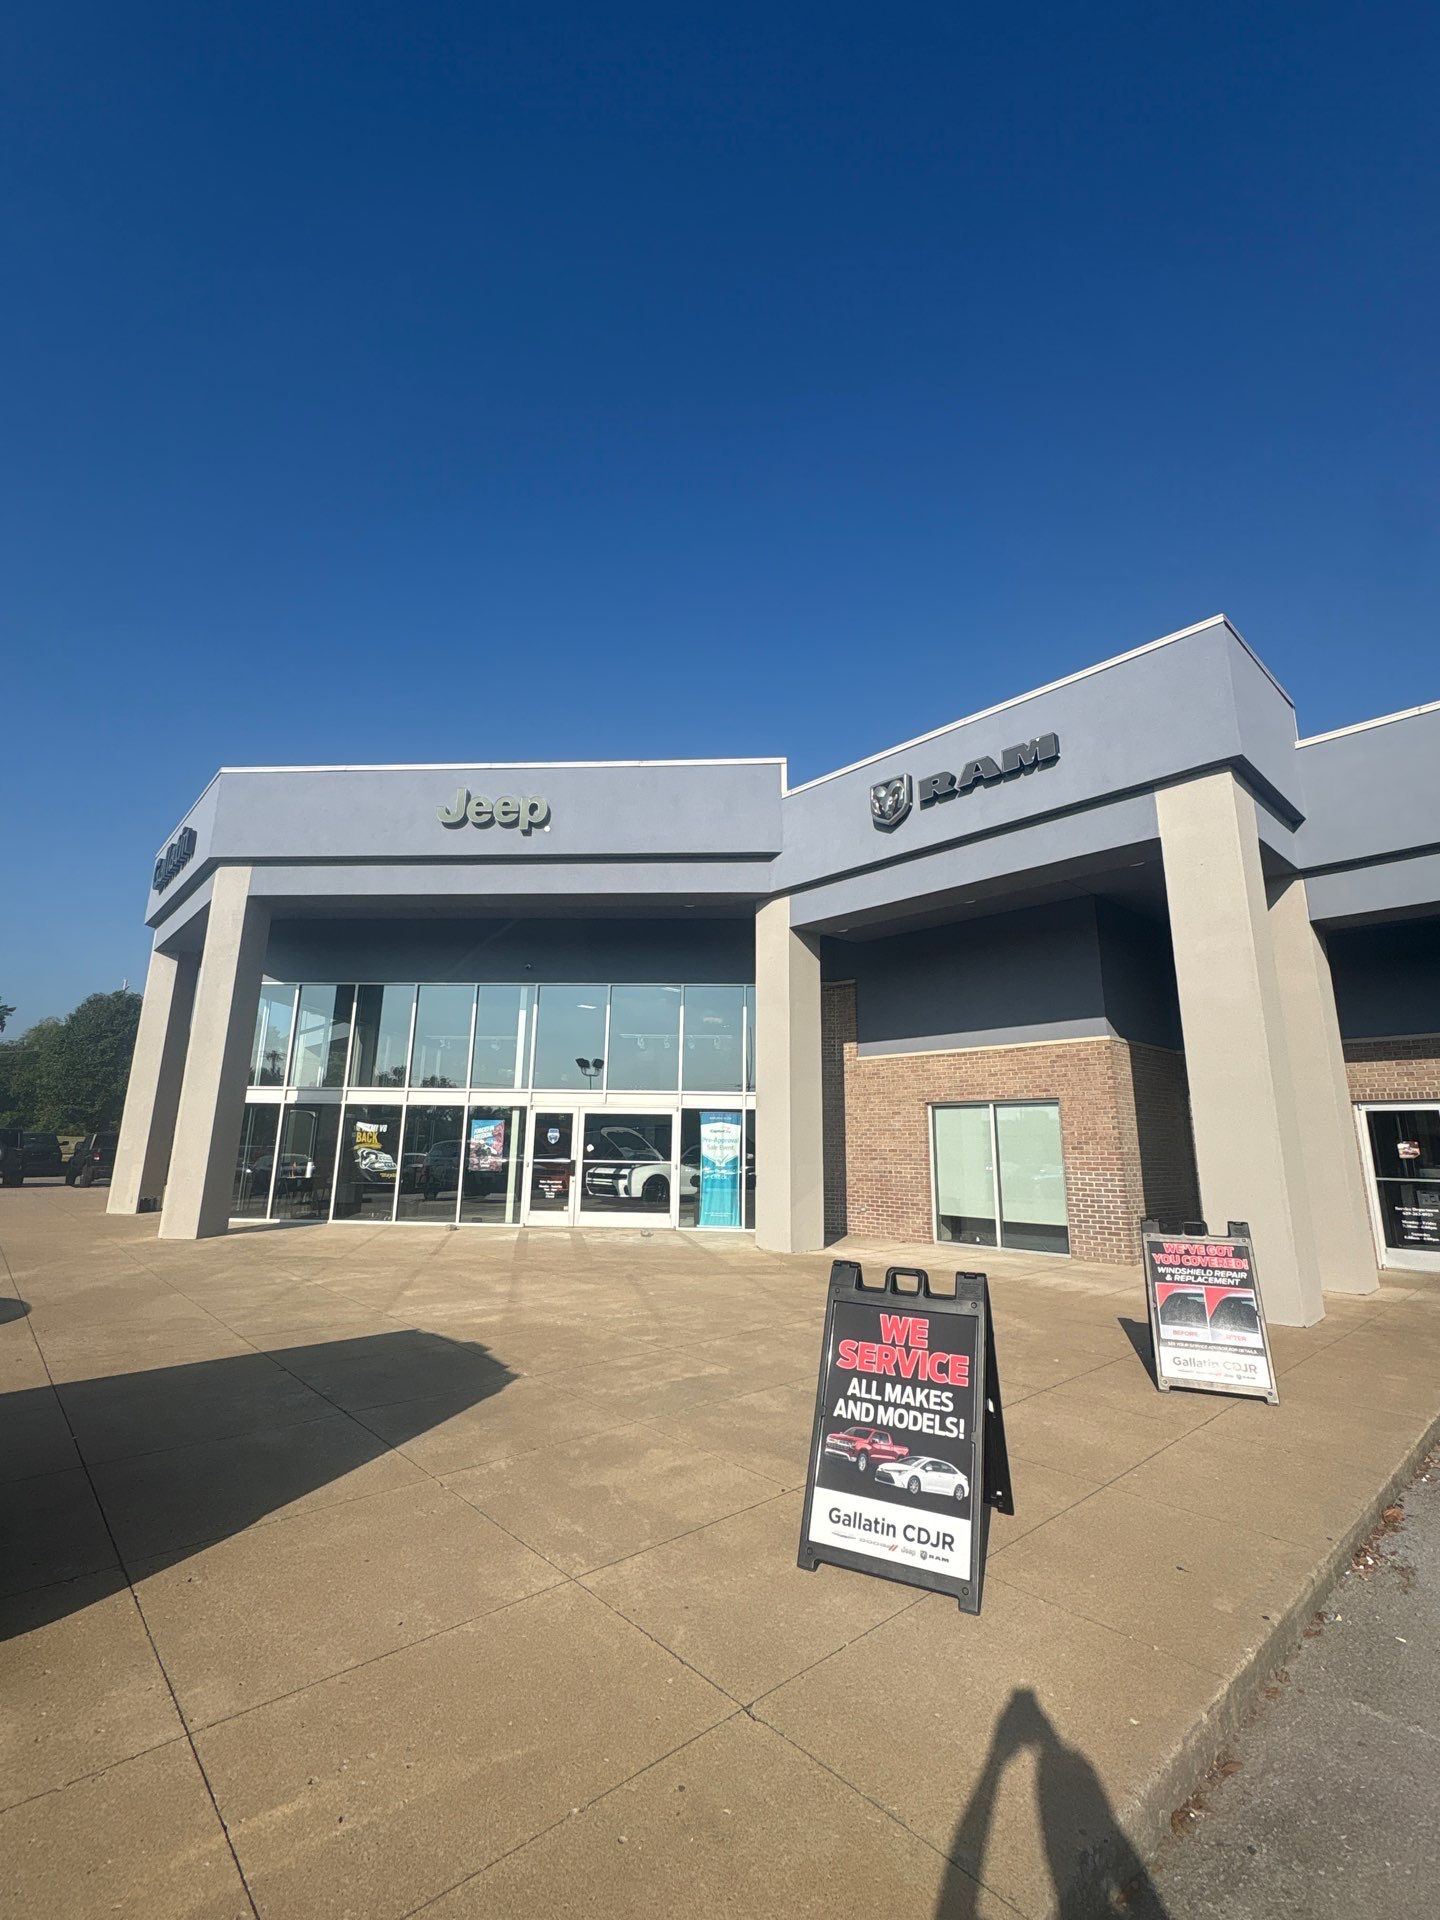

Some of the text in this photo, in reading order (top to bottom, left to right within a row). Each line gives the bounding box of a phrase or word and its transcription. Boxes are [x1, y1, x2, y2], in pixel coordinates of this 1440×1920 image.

[918, 732, 1060, 808] RAM
[436, 787, 549, 831] Jeep
[355, 1131, 379, 1144] BACK
[1162, 1242, 1235, 1257] WE'VE GOT
[1152, 1253, 1249, 1270] YOU COVERED!
[1157, 1266, 1248, 1279] WINDSHIELD REPAIR
[1165, 1273, 1241, 1286] & REPLACEMENT
[879, 1313, 930, 1349] WE
[1172, 1329, 1199, 1337] BEFORE
[836, 1339, 970, 1387] SERVICE
[1172, 1356, 1258, 1374] Gallatin CDJR
[847, 1377, 954, 1412] ALL MAKES
[833, 1398, 965, 1439] AND MODELS!
[828, 1506, 954, 1552] Gallatin CDJR
[928, 1554, 950, 1563] RAM
